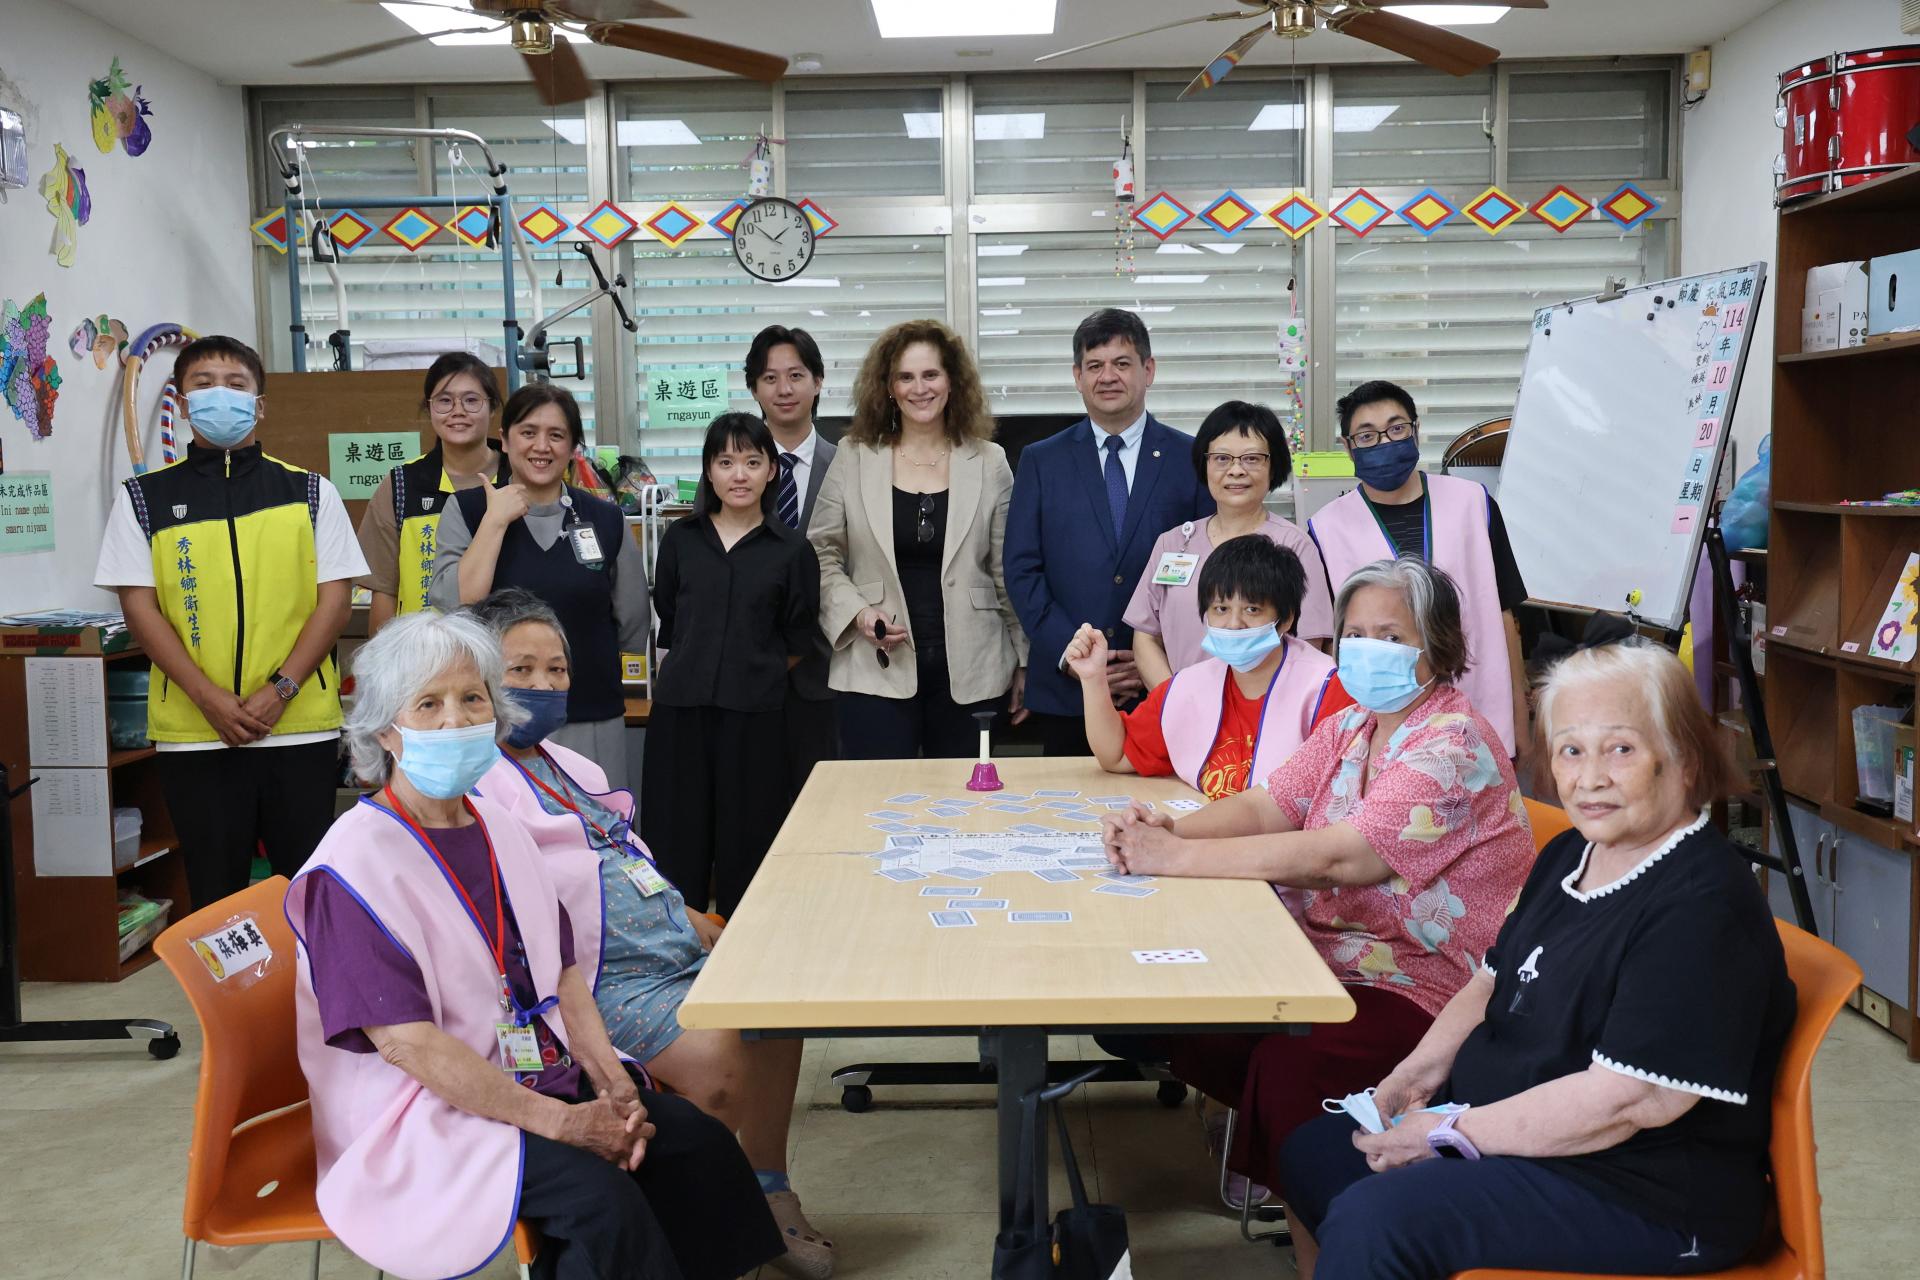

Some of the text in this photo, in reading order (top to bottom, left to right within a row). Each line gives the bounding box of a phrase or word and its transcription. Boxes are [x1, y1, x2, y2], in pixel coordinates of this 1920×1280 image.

[752, 209, 762, 223] 11
[764, 203, 777, 217] 12
[783, 206, 788, 219] 1
[742, 222, 754, 236] 10
[794, 216, 802, 229] 2
[738, 237, 746, 250] 9
[802, 231, 809, 244] 3
[745, 252, 753, 265] 8
[797, 246, 804, 259] 4
[758, 262, 765, 274] 7
[773, 264, 781, 276] 6
[788, 259, 796, 271] 5
[1728, 277, 1753, 297] 日期
[1722, 307, 1745, 329] 114
[1720, 336, 1731, 356] 年
[1713, 366, 1727, 384] 10
[654, 379, 720, 401] 桌遊區
[1706, 395, 1718, 414] 月
[667, 411, 711, 421] rngayun
[1699, 422, 1713, 440] 20
[345, 442, 405, 463] 桌遊區
[1692, 458, 1702, 473] 日
[0, 483, 48, 498] 未完成作品區
[1678, 481, 1703, 501] 星期
[420, 524, 435, 612] 秀林鄉衛生
[176, 536, 201, 648] 秀林鄉衛生所
